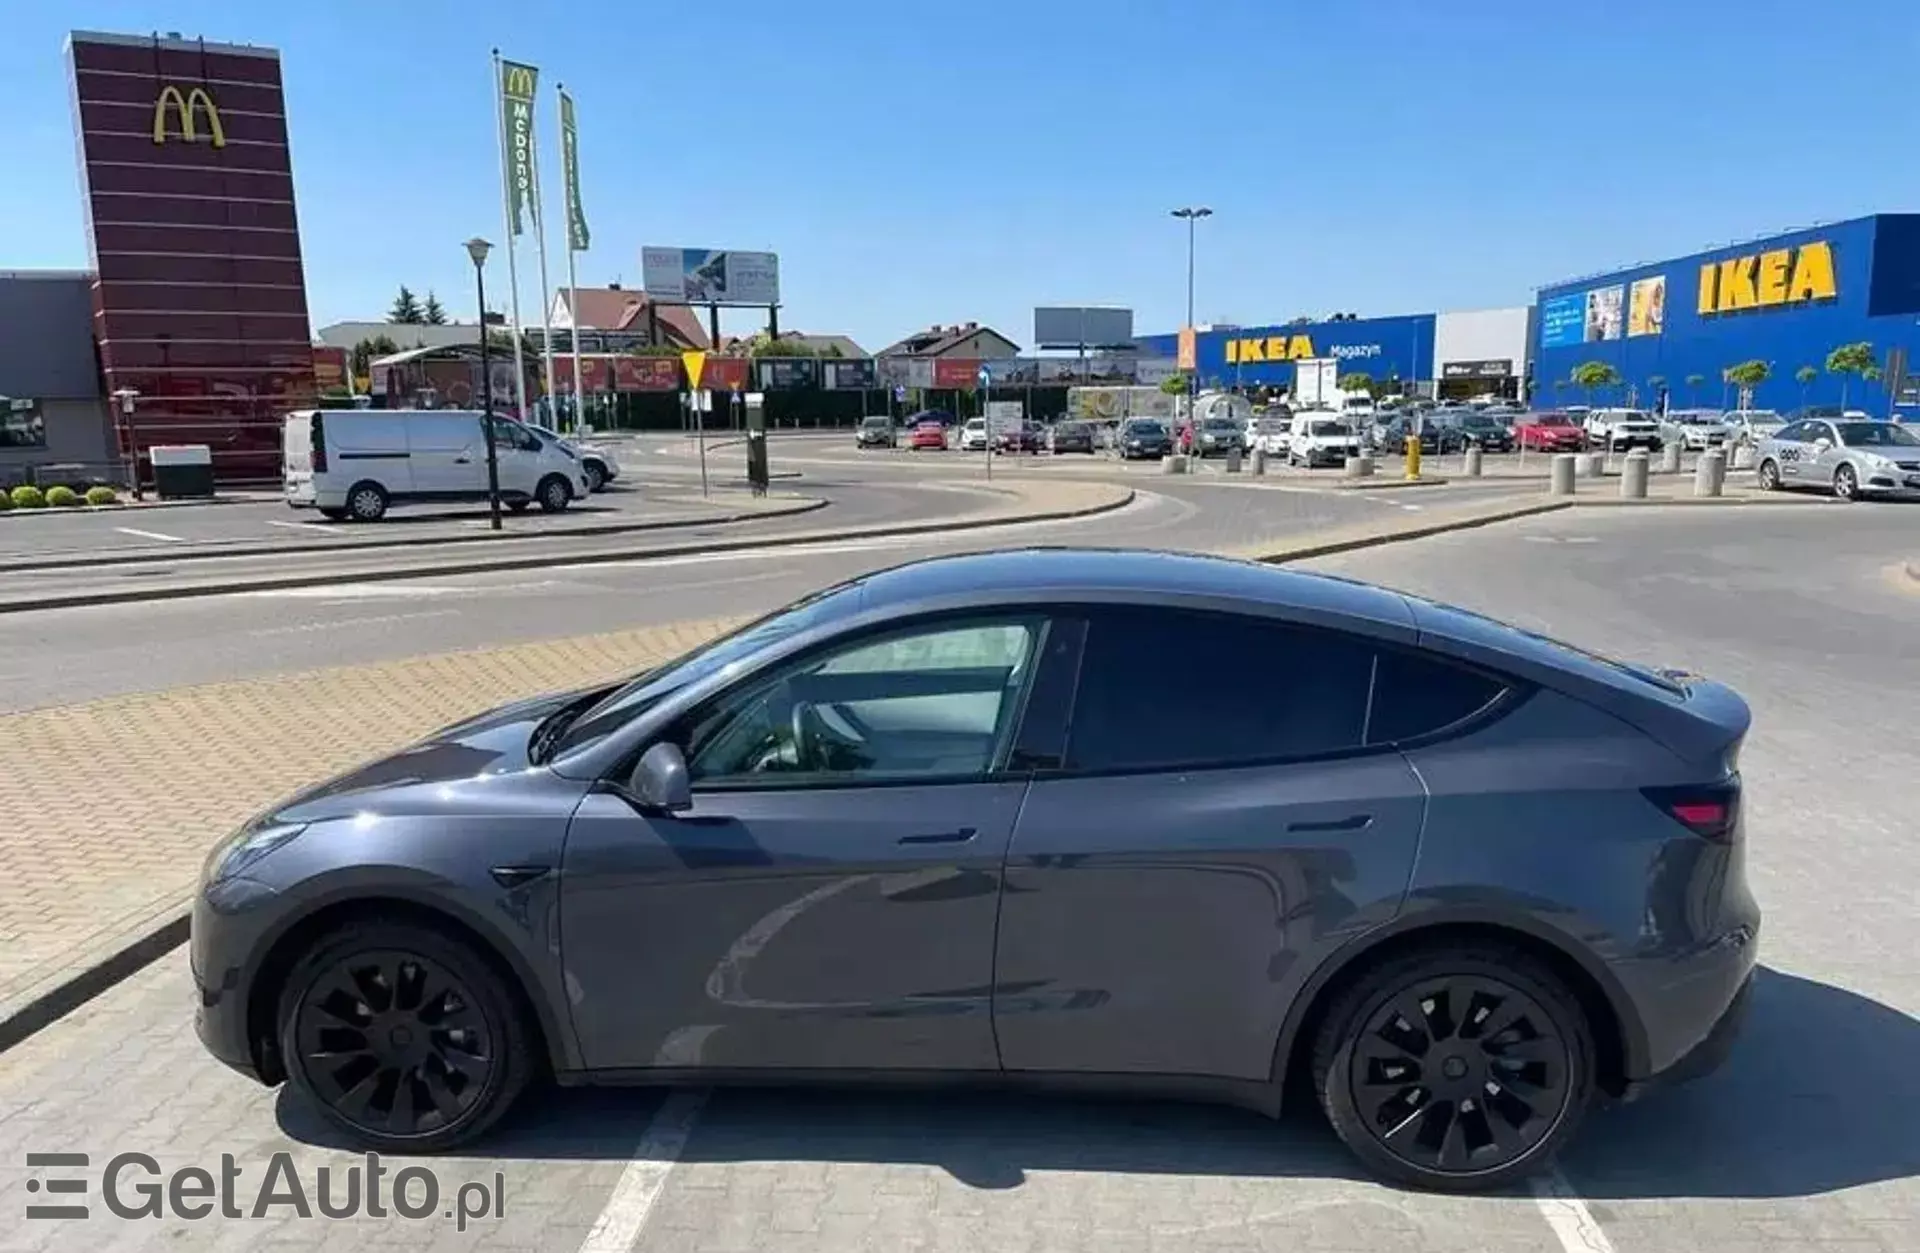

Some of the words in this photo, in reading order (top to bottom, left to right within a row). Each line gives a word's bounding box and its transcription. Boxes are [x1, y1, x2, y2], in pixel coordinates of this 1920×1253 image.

[1698, 240, 1837, 315] IKEA
[1225, 335, 1315, 363] IKEA
[1330, 344, 1381, 360] Magazyn
